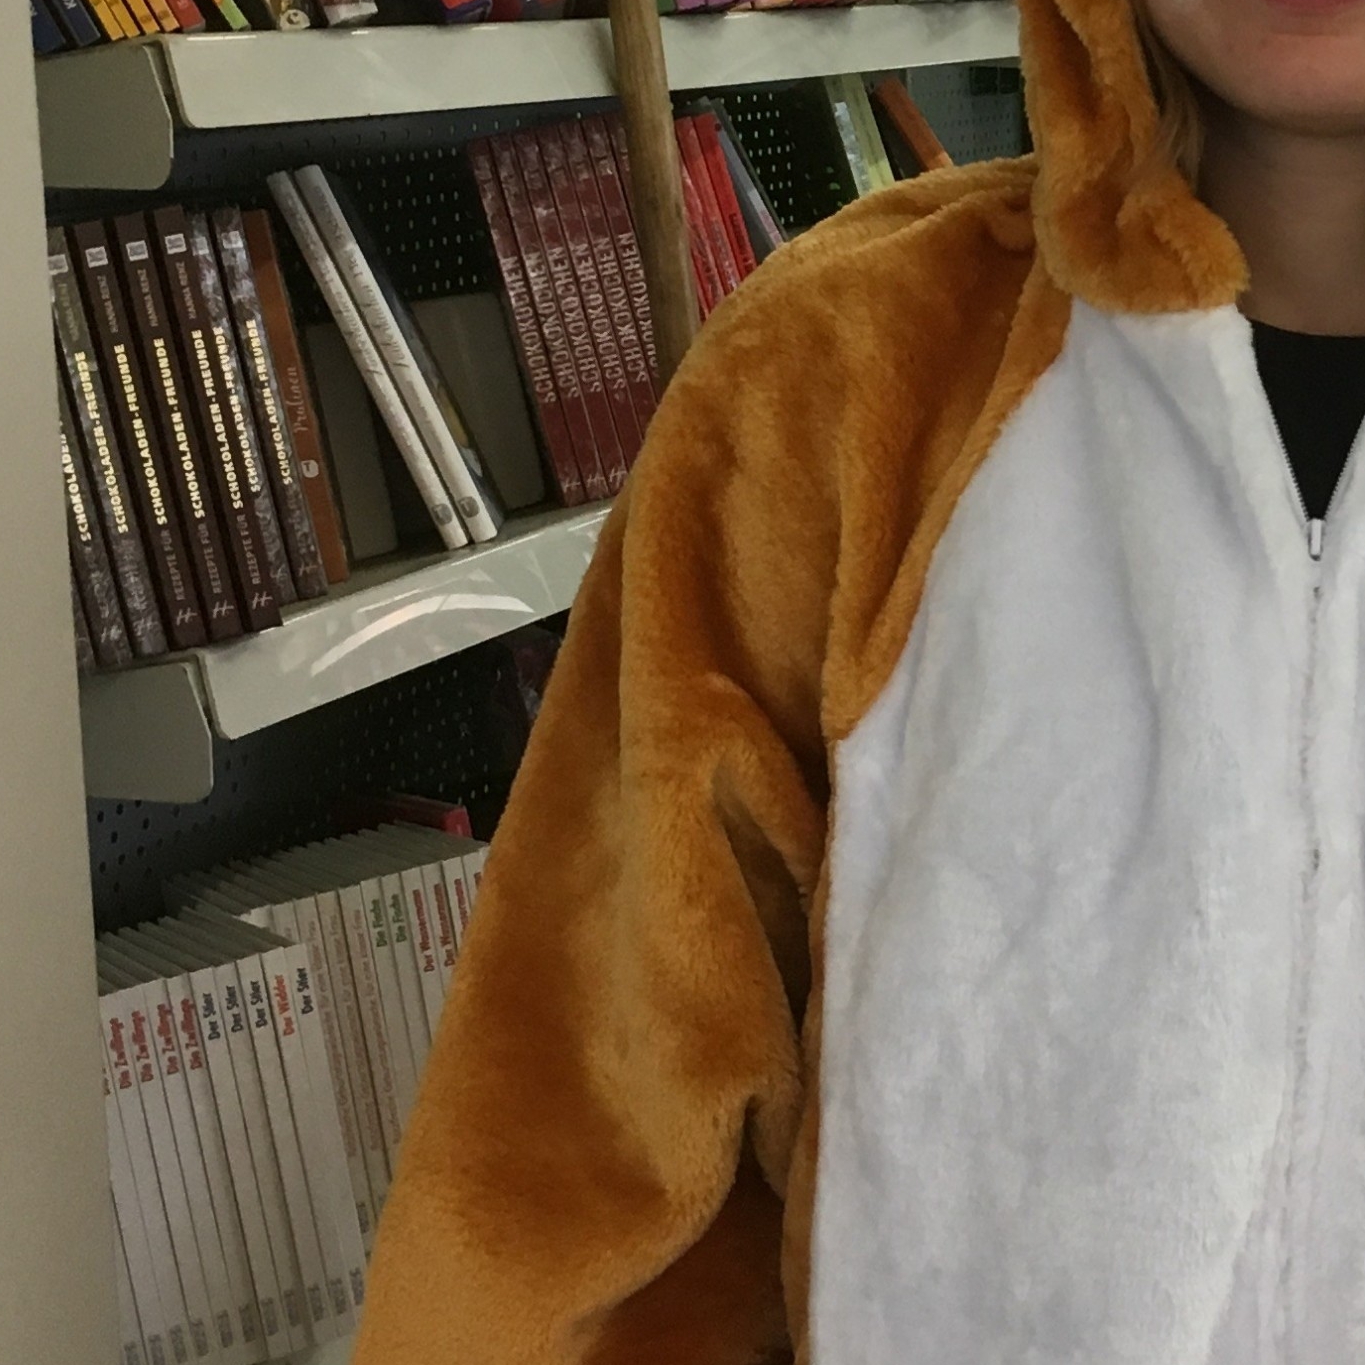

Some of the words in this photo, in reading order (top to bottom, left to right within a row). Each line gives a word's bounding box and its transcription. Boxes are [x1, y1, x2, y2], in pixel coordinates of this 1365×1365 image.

[500, 256, 556, 403] SCHOKOKUCHEN
[524, 252, 580, 398] SCHOKOKUCHEN
[548, 246, 601, 392] SCHOKOKUCHEN
[570, 243, 626, 389] SCHOKOKUCHEN
[593, 237, 647, 383] SCHOKOKUCHEN
[191, 330, 244, 509] SCHOKOLADEN-FREUNDE
[213, 326, 261, 493] SCHOKOLADEN-FREUNDE
[246, 319, 293, 485] SCHOKOLADEN-FREUNDE
[74, 352, 129, 533] SCHOKOLADEN-FREUNDE
[114, 344, 168, 526] SCHOKOLADEN-FREUNDE
[153, 338, 205, 518] SCHOKOLADEN-FREUNDE
[165, 554, 185, 601] REZEPTE
[203, 546, 222, 594] REZEPTE
[243, 538, 261, 585] REZEPTE
[297, 967, 309, 992] Stier
[422, 954, 434, 972] Der
[203, 993, 216, 1017] Stier
[226, 986, 239, 1010] Stier
[251, 980, 263, 1005] Stier
[274, 975, 291, 1014] Widder
[302, 996, 314, 1014] Der
[208, 1022, 221, 1040] Der
[231, 1014, 244, 1032] Der
[255, 1010, 268, 1028] Der
[283, 1018, 295, 1036] Der
